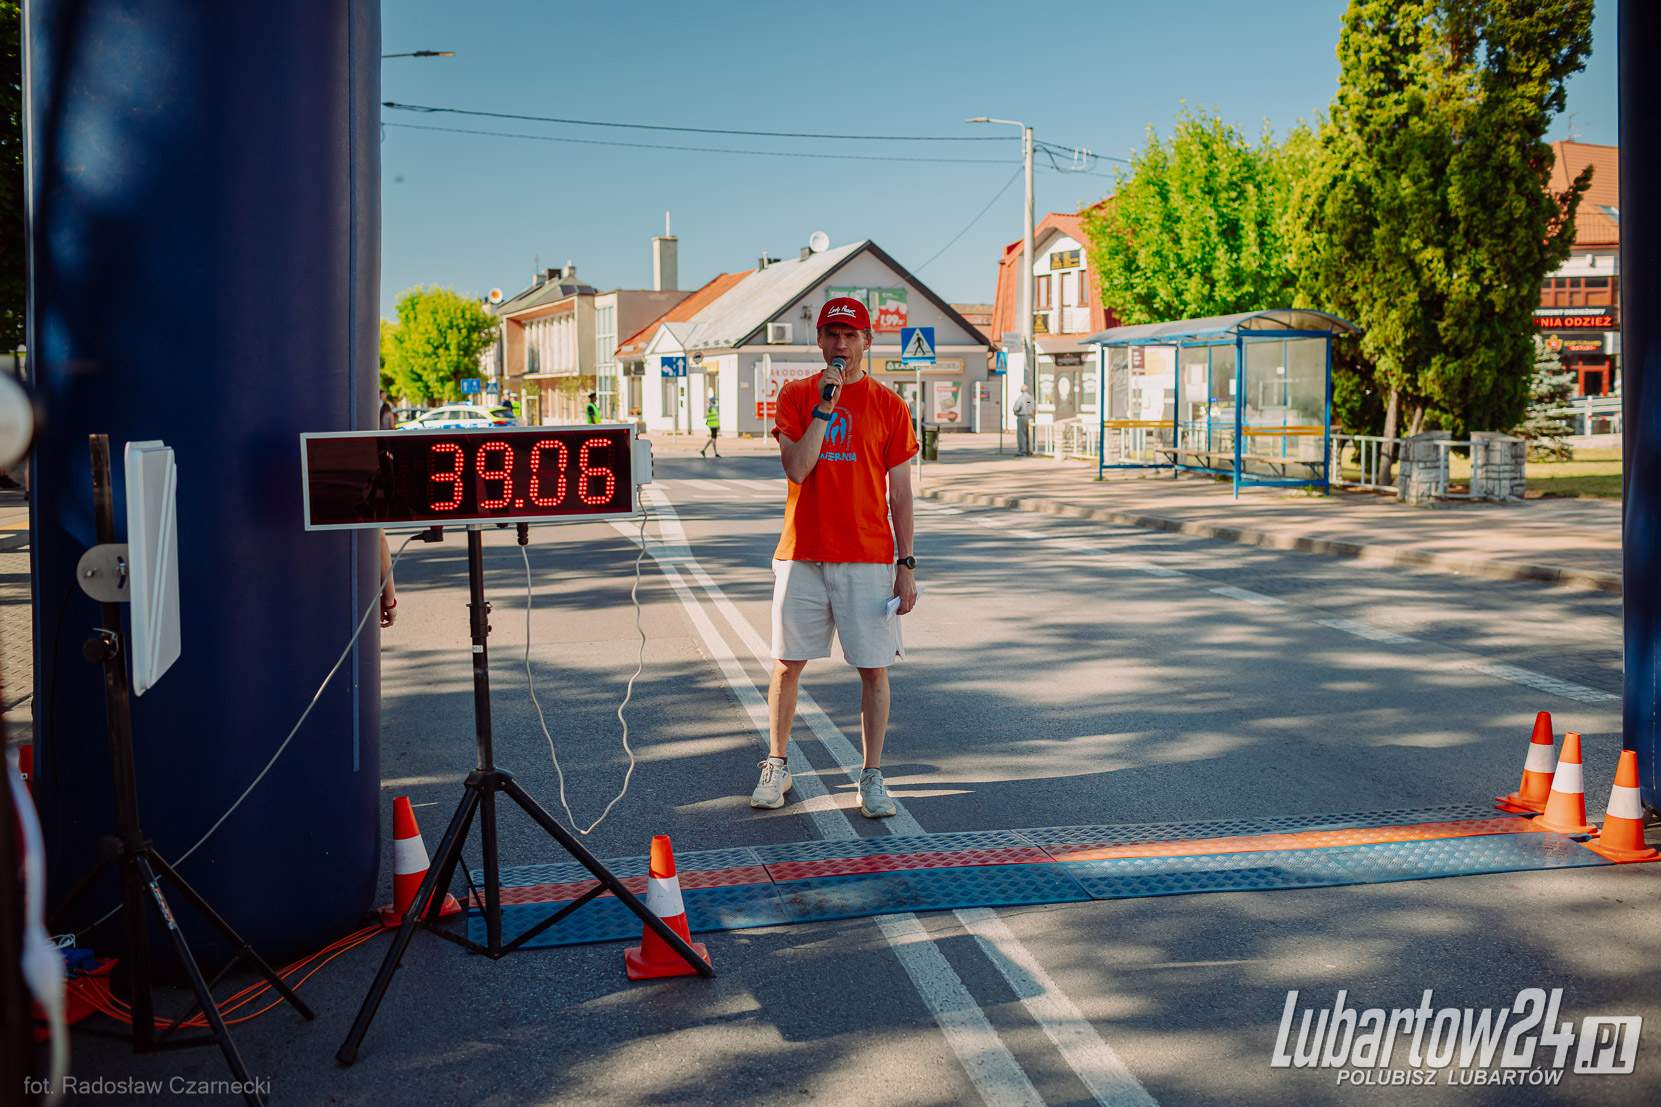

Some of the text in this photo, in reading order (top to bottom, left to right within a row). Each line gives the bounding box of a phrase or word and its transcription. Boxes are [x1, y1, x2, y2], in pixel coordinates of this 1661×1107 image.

[1540, 315, 1612, 328] NIA ODZIEŻ
[430, 438, 616, 511] 39.06
